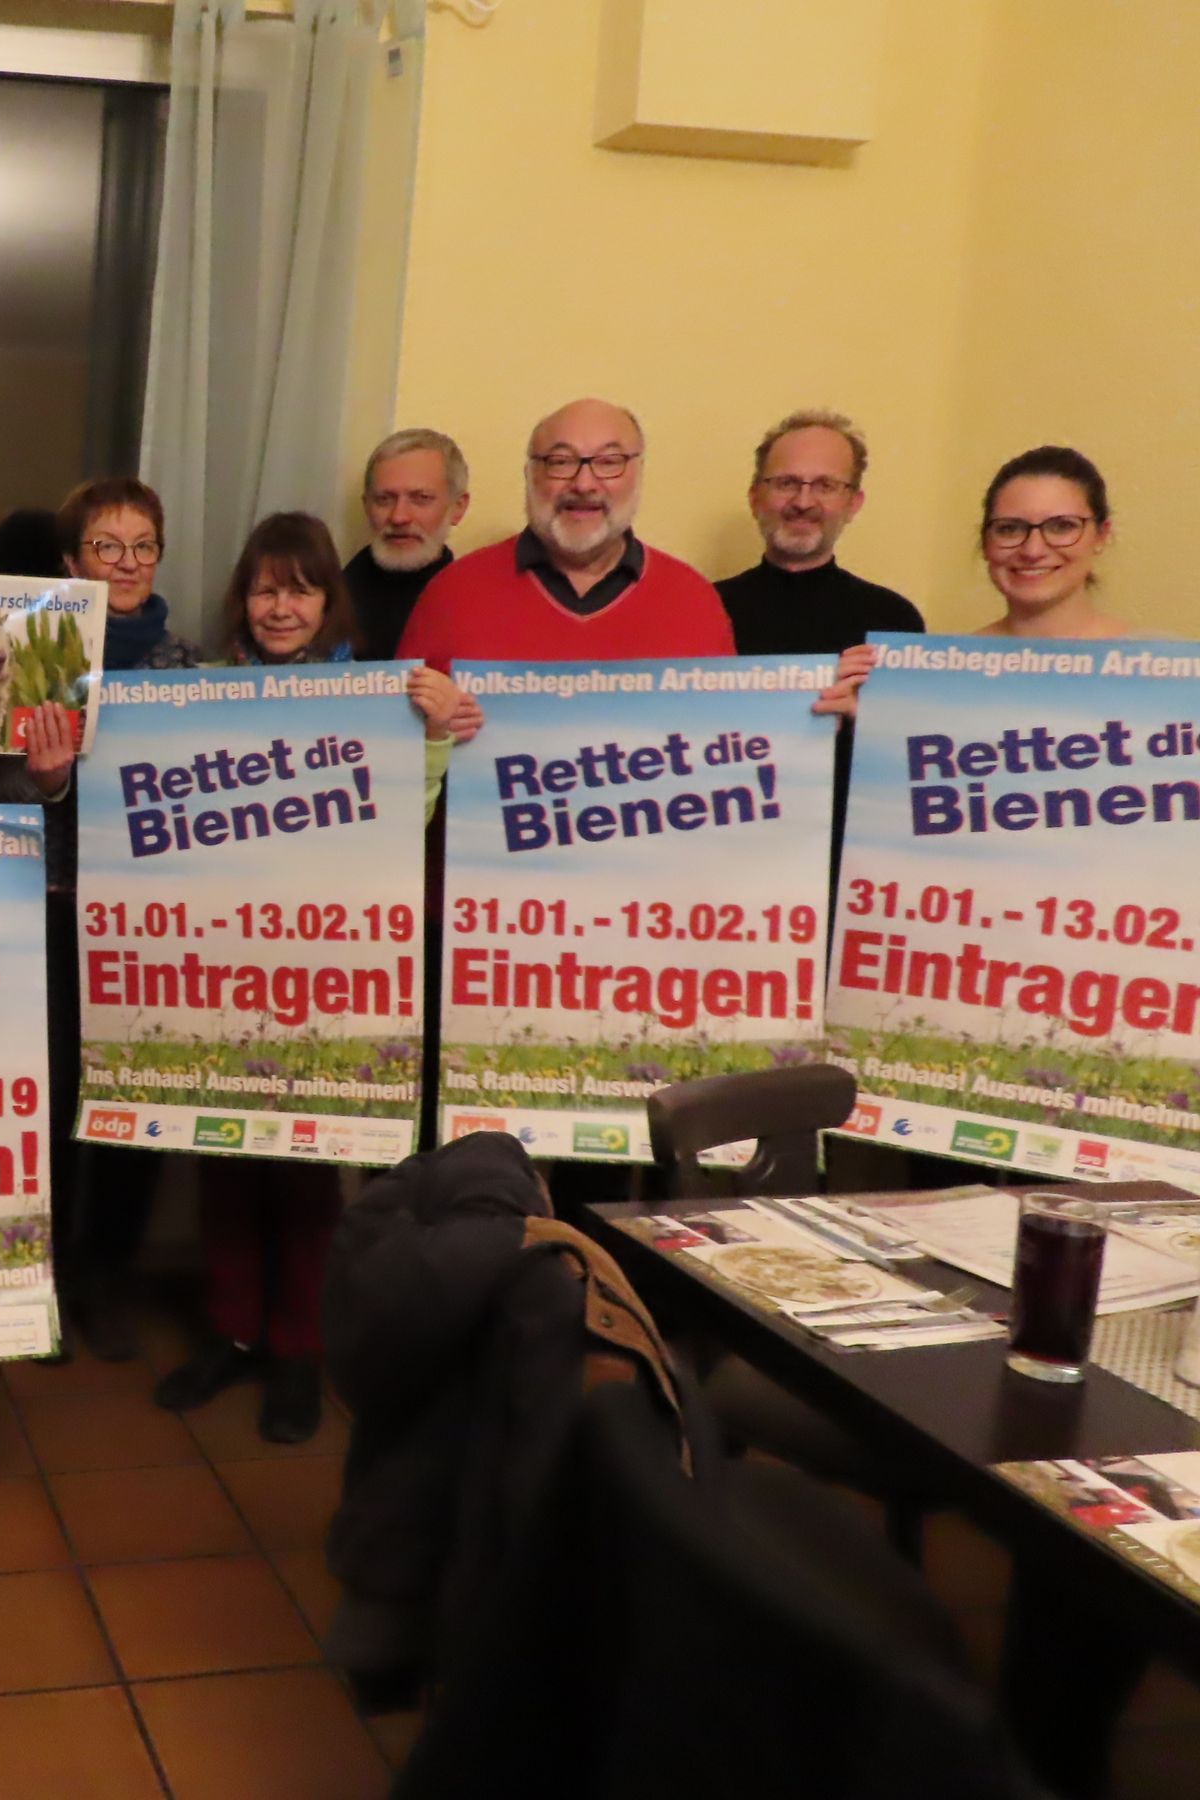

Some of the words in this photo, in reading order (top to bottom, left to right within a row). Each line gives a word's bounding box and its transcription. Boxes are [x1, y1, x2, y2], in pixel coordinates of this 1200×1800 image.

[262, 670, 410, 699] Artenvielfal
[455, 669, 653, 698] Volksbegehren
[659, 665, 834, 692] Artenvielfalt
[119, 738, 296, 808] Rettet
[304, 735, 364, 770] die
[495, 733, 693, 800] Rettet
[704, 731, 771, 767] die
[907, 720, 1134, 782] Rettet
[1147, 722, 1200, 758] di
[127, 766, 377, 858] Bienen!
[502, 764, 781, 853] Bienen!
[911, 780, 1200, 836] Bienen
[87, 950, 414, 1027] Eintragen!
[452, 947, 815, 1030] Eintragen!
[86, 1065, 115, 1086] Ins
[119, 1066, 202, 1090] Rathaus!
[207, 1072, 288, 1096] Ausweis
[293, 1077, 416, 1101] mitnehmen!
[446, 1069, 477, 1089] Ins
[483, 1070, 577, 1094] Rathaus!
[582, 1076, 671, 1098] Auswe
[864, 1056, 968, 1092] Rathaus!
[971, 1074, 1076, 1109] Ausweis
[91, 1117, 132, 1138] ödp
